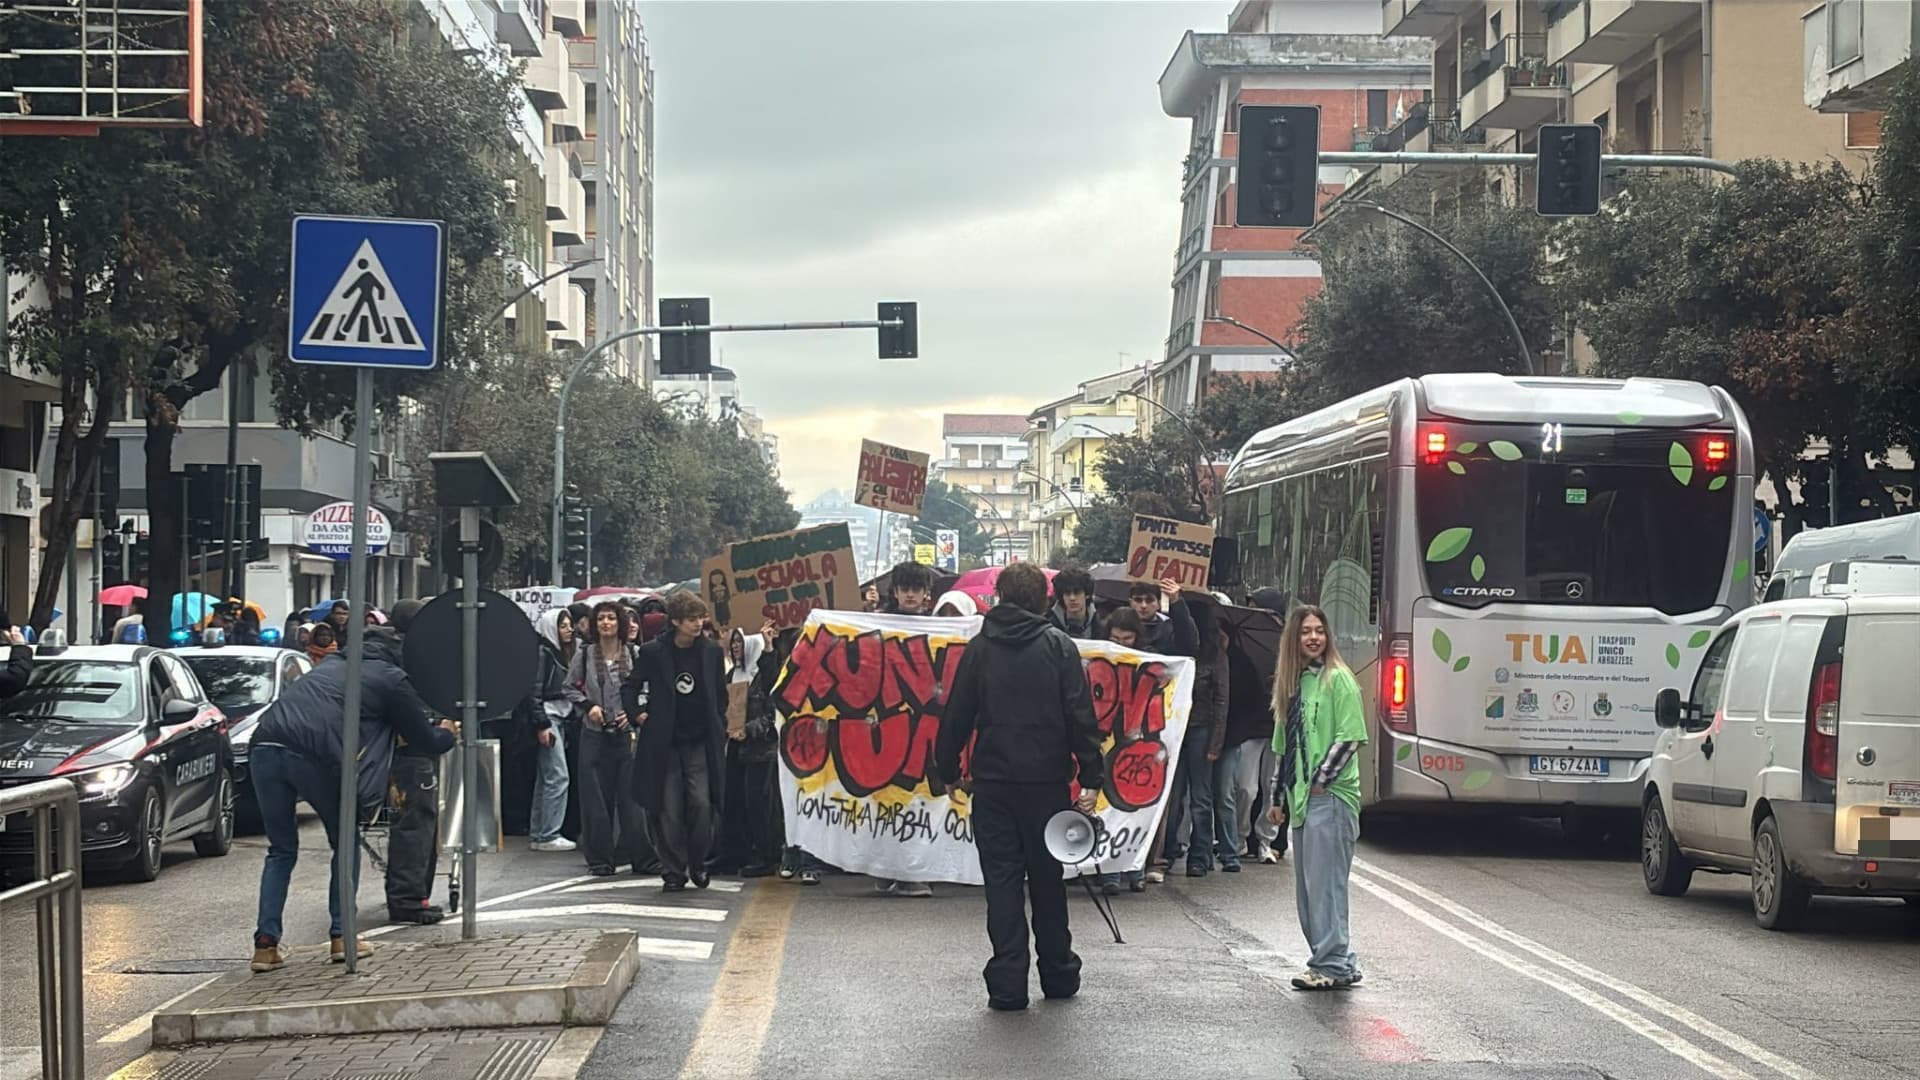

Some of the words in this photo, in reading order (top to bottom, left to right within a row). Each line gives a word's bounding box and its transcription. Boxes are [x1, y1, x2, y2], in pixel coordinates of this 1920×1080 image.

[1541, 423, 1562, 453] 21
[313, 505, 384, 524] PIZZIA
[312, 524, 330, 533] DA
[331, 524, 384, 534] ASPTO
[1136, 515, 1179, 535] TANTE
[1151, 536, 1211, 558] PROMESSE
[757, 552, 837, 592] SCUOLA
[1153, 556, 1206, 587] FATTI
[1505, 634, 1588, 665] TUA
[1598, 635, 1636, 646] TRASPORTO
[1598, 646, 1625, 656] UNICO
[1422, 755, 1465, 772] 9015
